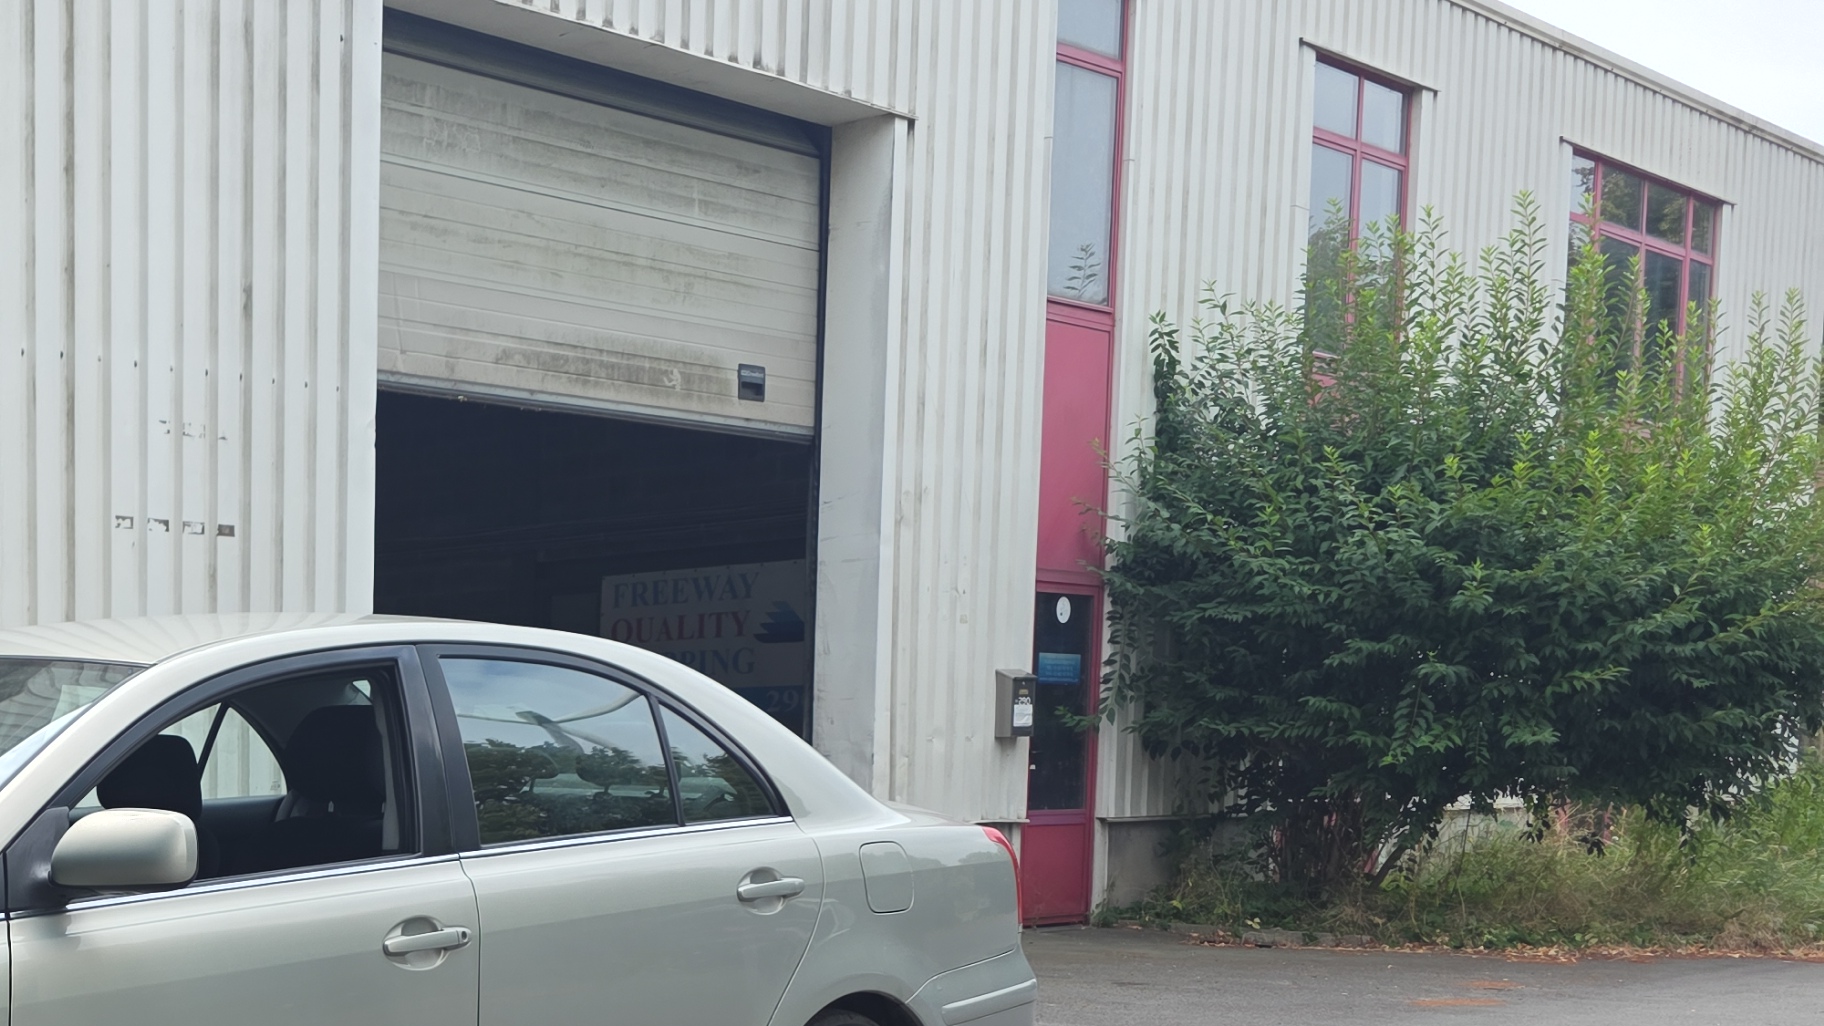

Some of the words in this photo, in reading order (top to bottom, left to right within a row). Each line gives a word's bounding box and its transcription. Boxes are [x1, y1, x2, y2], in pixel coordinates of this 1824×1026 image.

[613, 572, 760, 609] FREEWAY
[610, 610, 750, 644] QUALITY
[766, 689, 801, 712] 29
